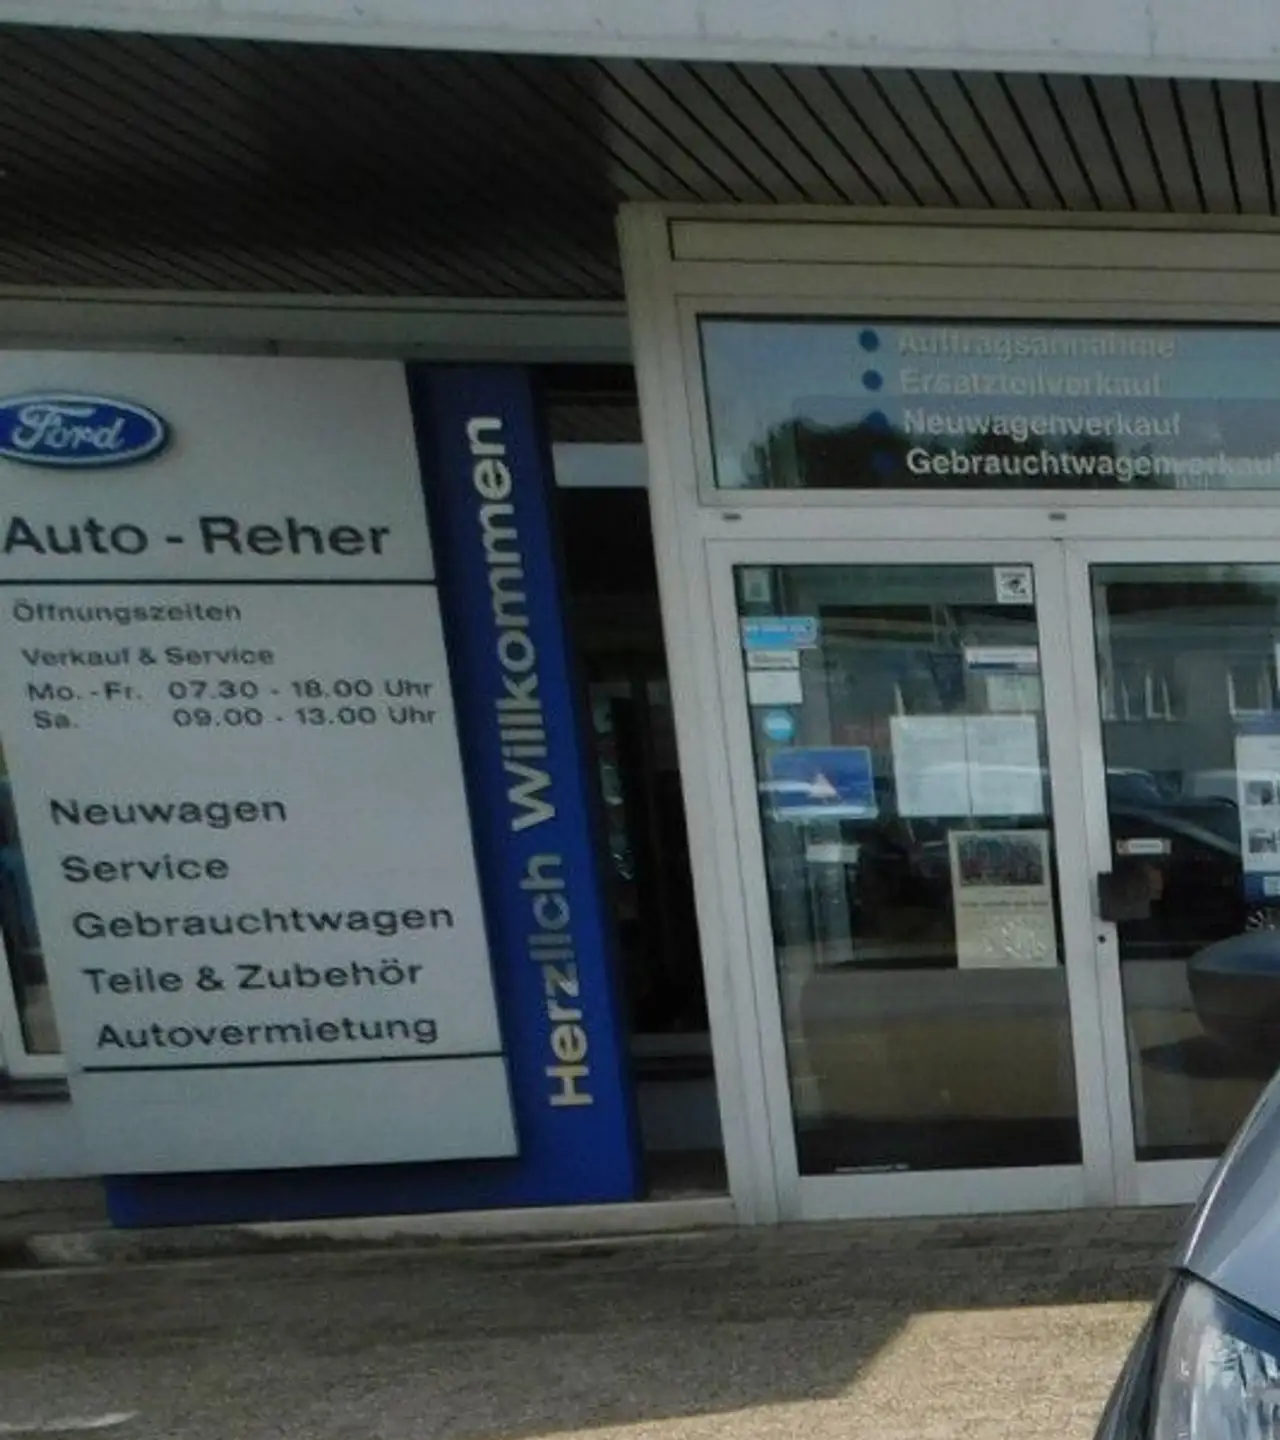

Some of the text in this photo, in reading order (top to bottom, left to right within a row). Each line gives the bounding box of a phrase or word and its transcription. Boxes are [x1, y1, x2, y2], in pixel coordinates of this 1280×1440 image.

[900, 329, 1176, 362] Auftragsannahme
[901, 367, 1163, 397] Ersatzteilverkauf
[10, 403, 126, 452] Ford
[903, 408, 1182, 441] Neuwagenverkauf
[2, 516, 150, 556] Auto
[199, 515, 391, 556] Reher
[13, 598, 242, 626] Öffnungszeiten
[21, 646, 275, 666] Verkauf & Service
[168, 680, 259, 700] 07.30
[291, 678, 373, 699] 18.00
[384, 678, 433, 699] Uhr
[172, 707, 264, 728] 09.00
[296, 706, 377, 726] 13.00
[388, 704, 437, 726] Uhr
[465, 415, 594, 1107] Herzlich Willkommen
[50, 799, 288, 829] Neuwagen
[60, 854, 230, 883] Service
[73, 904, 455, 940] Gebrauchtwagen
[83, 959, 424, 995] Teile & Zubehör
[96, 1014, 439, 1050] Autovermietung
